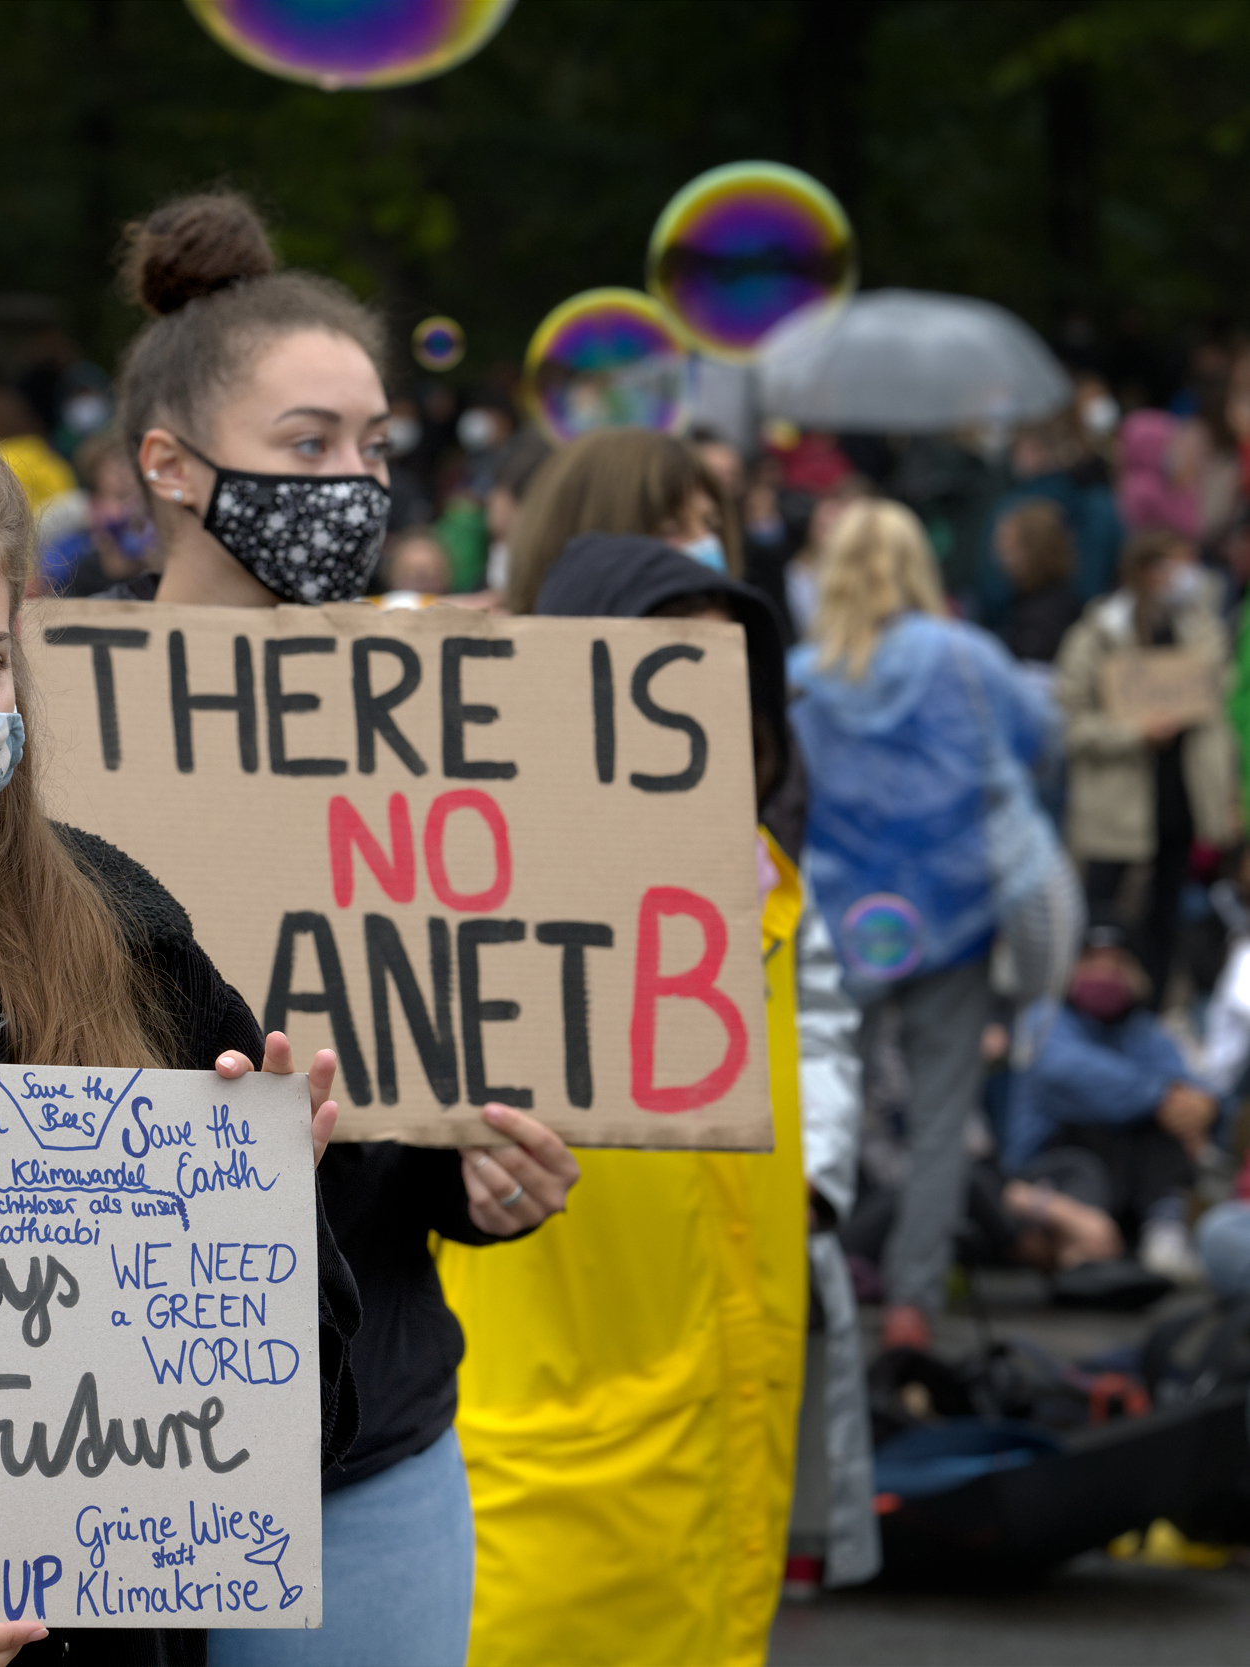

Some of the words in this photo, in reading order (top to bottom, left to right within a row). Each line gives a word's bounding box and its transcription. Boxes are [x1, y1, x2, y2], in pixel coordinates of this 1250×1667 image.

[44, 625, 518, 779] THERE
[592, 638, 707, 793] IS
[327, 789, 513, 912] NO
[264, 912, 614, 1110] ANET
[630, 885, 748, 1115] B
[20, 1072, 74, 1099] Save
[82, 1075, 115, 1104] the
[39, 1103, 95, 1137] Bees
[122, 1096, 197, 1159] Save
[207, 1104, 258, 1146] the
[11, 1158, 151, 1190] Klimawandel
[176, 1150, 281, 1199] Earth
[89, 1195, 122, 1215] als
[111, 1242, 172, 1290] WE
[191, 1242, 297, 1286] NEED
[111, 1310, 131, 1327] a
[146, 1293, 266, 1330] GREEN
[142, 1335, 300, 1386] WORLD
[75, 1505, 177, 1568] Grüne
[189, 1501, 285, 1546] Wiese
[152, 1544, 196, 1568] statt
[3, 1554, 63, 1621] UP
[77, 1569, 268, 1617] Klimakrise
